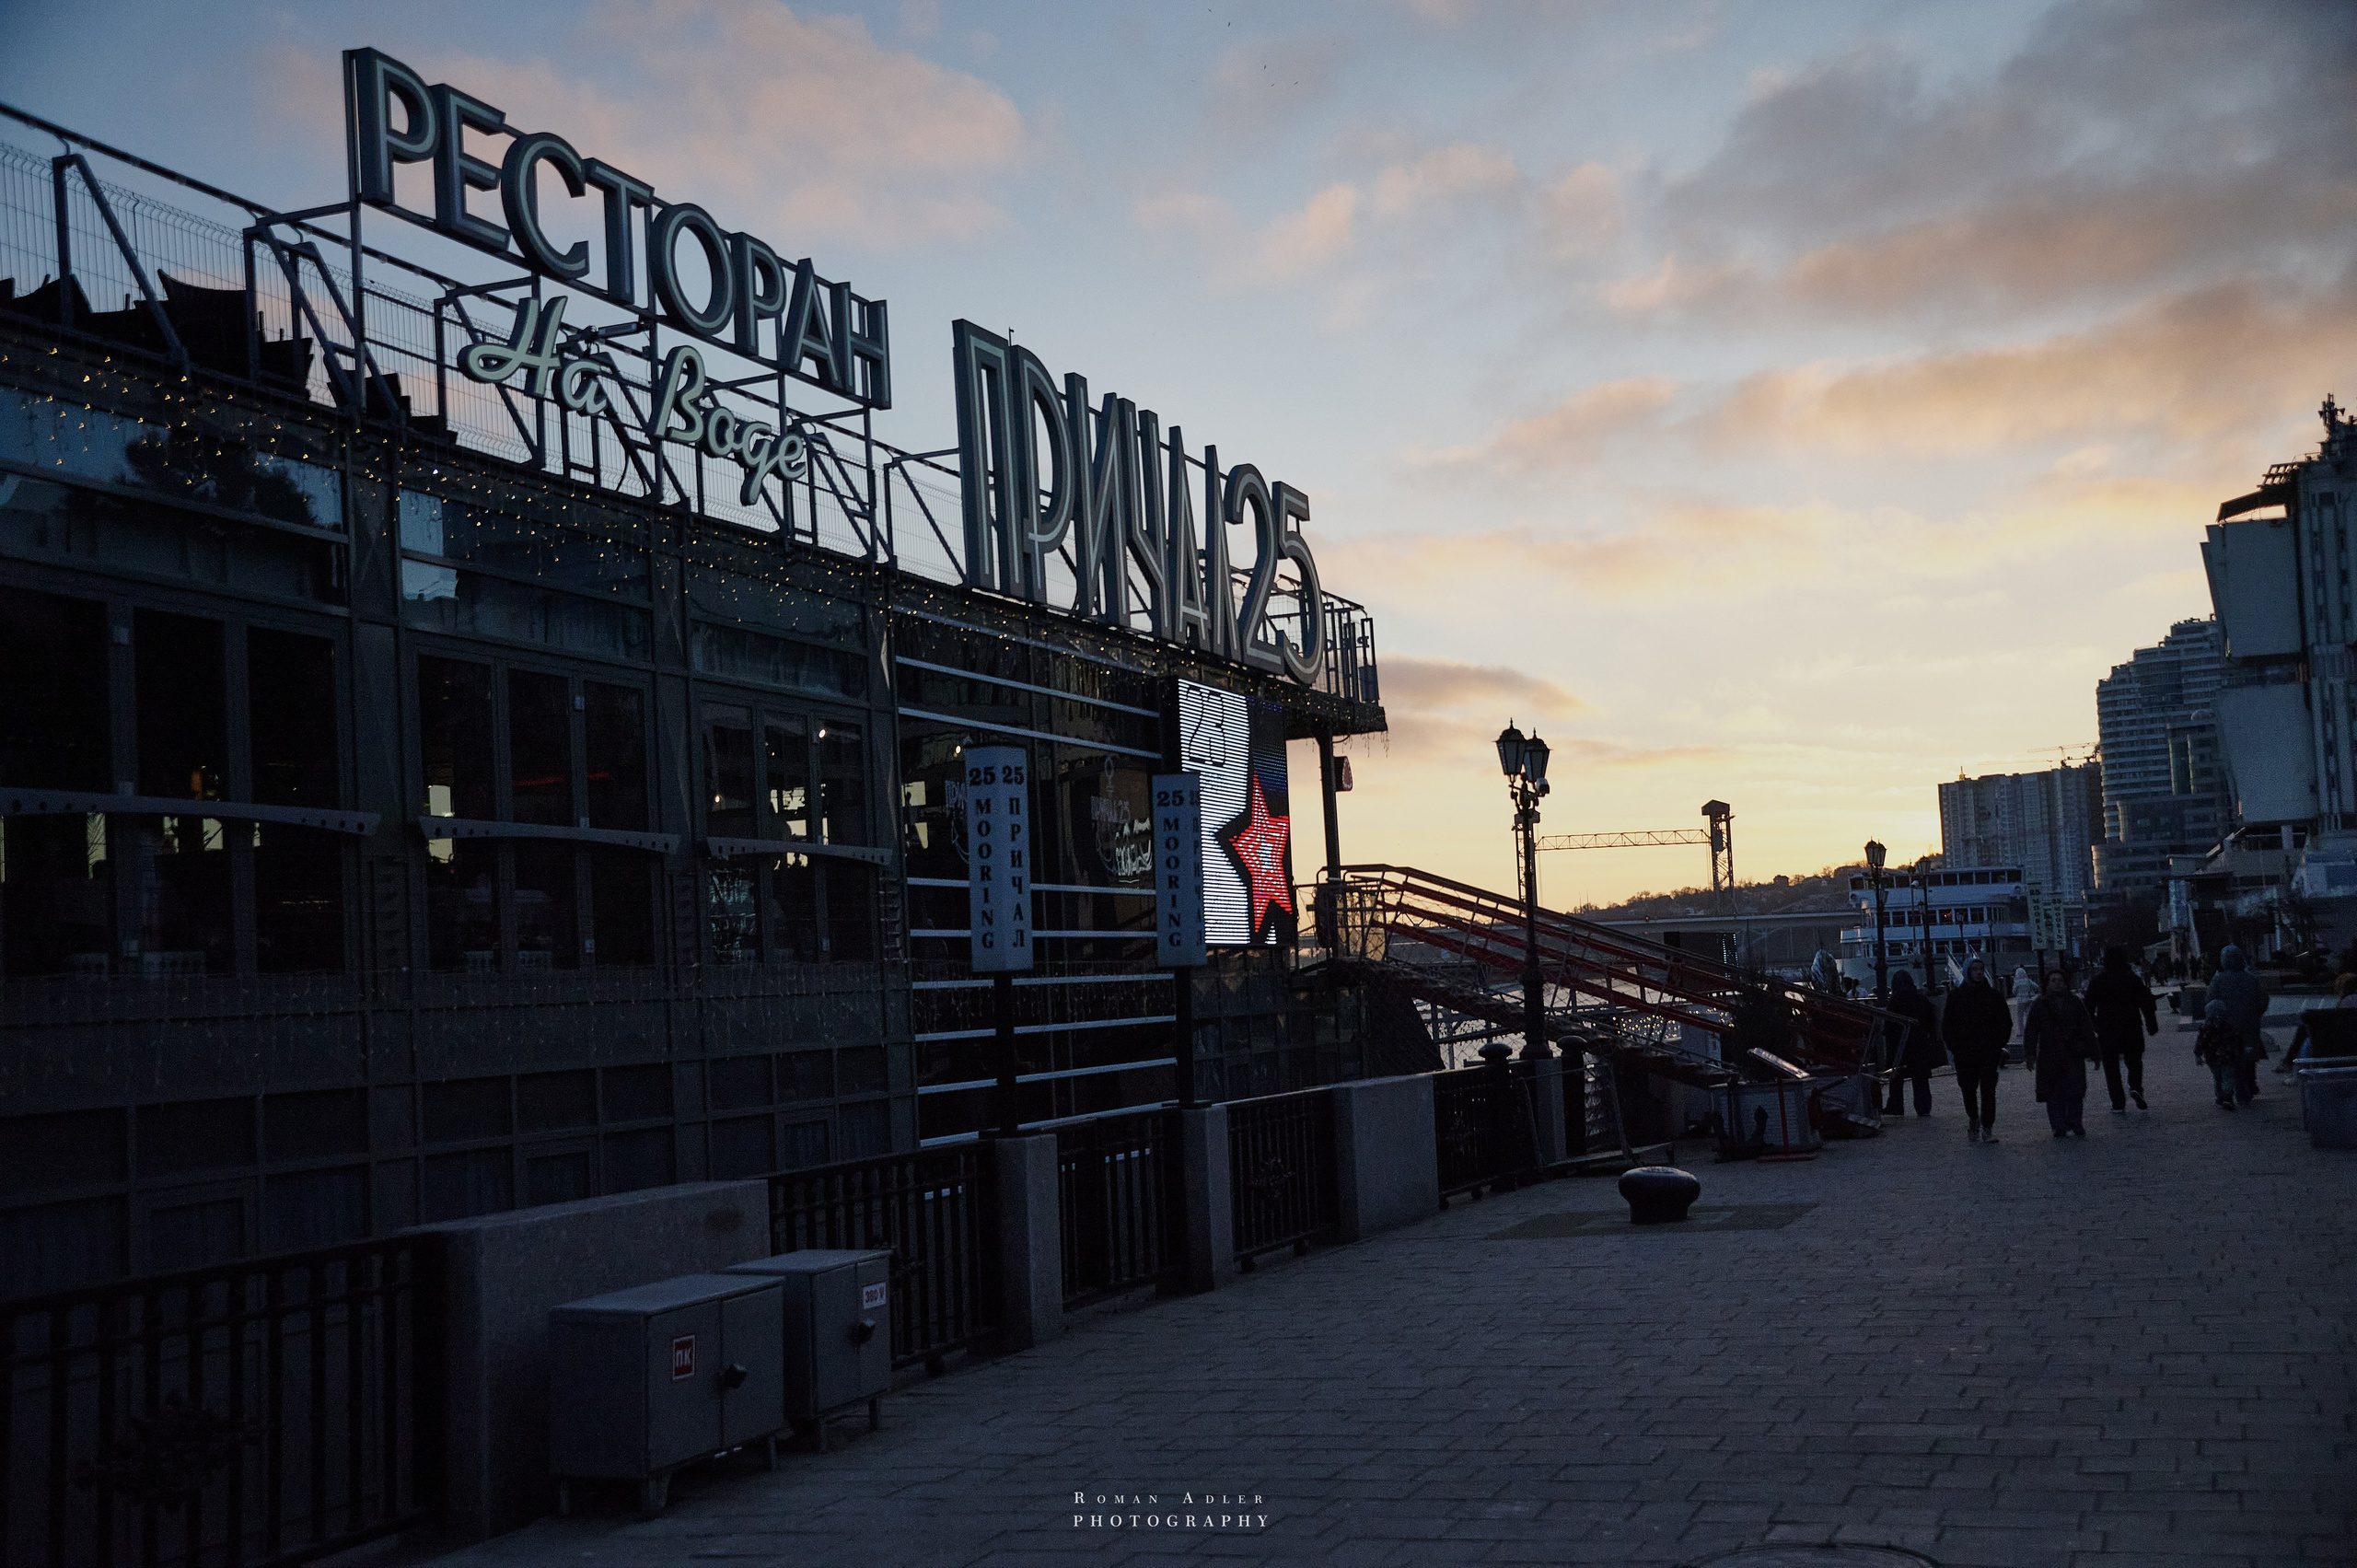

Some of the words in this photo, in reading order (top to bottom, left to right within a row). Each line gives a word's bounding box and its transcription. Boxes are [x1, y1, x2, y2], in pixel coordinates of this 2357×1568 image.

[355, 47, 891, 410] РЕСТОРАН
[457, 296, 609, 415] На
[969, 767, 995, 785] 25
[1003, 765, 1025, 784] 25
[1156, 791, 1184, 807] 25
[975, 798, 993, 949] MOORING
[1009, 797, 1026, 947] ПРИЧАЛ
[1164, 818, 1181, 947] MOORING
[2033, 899, 2042, 944] MOORING
[676, 1348, 691, 1367] ПК
